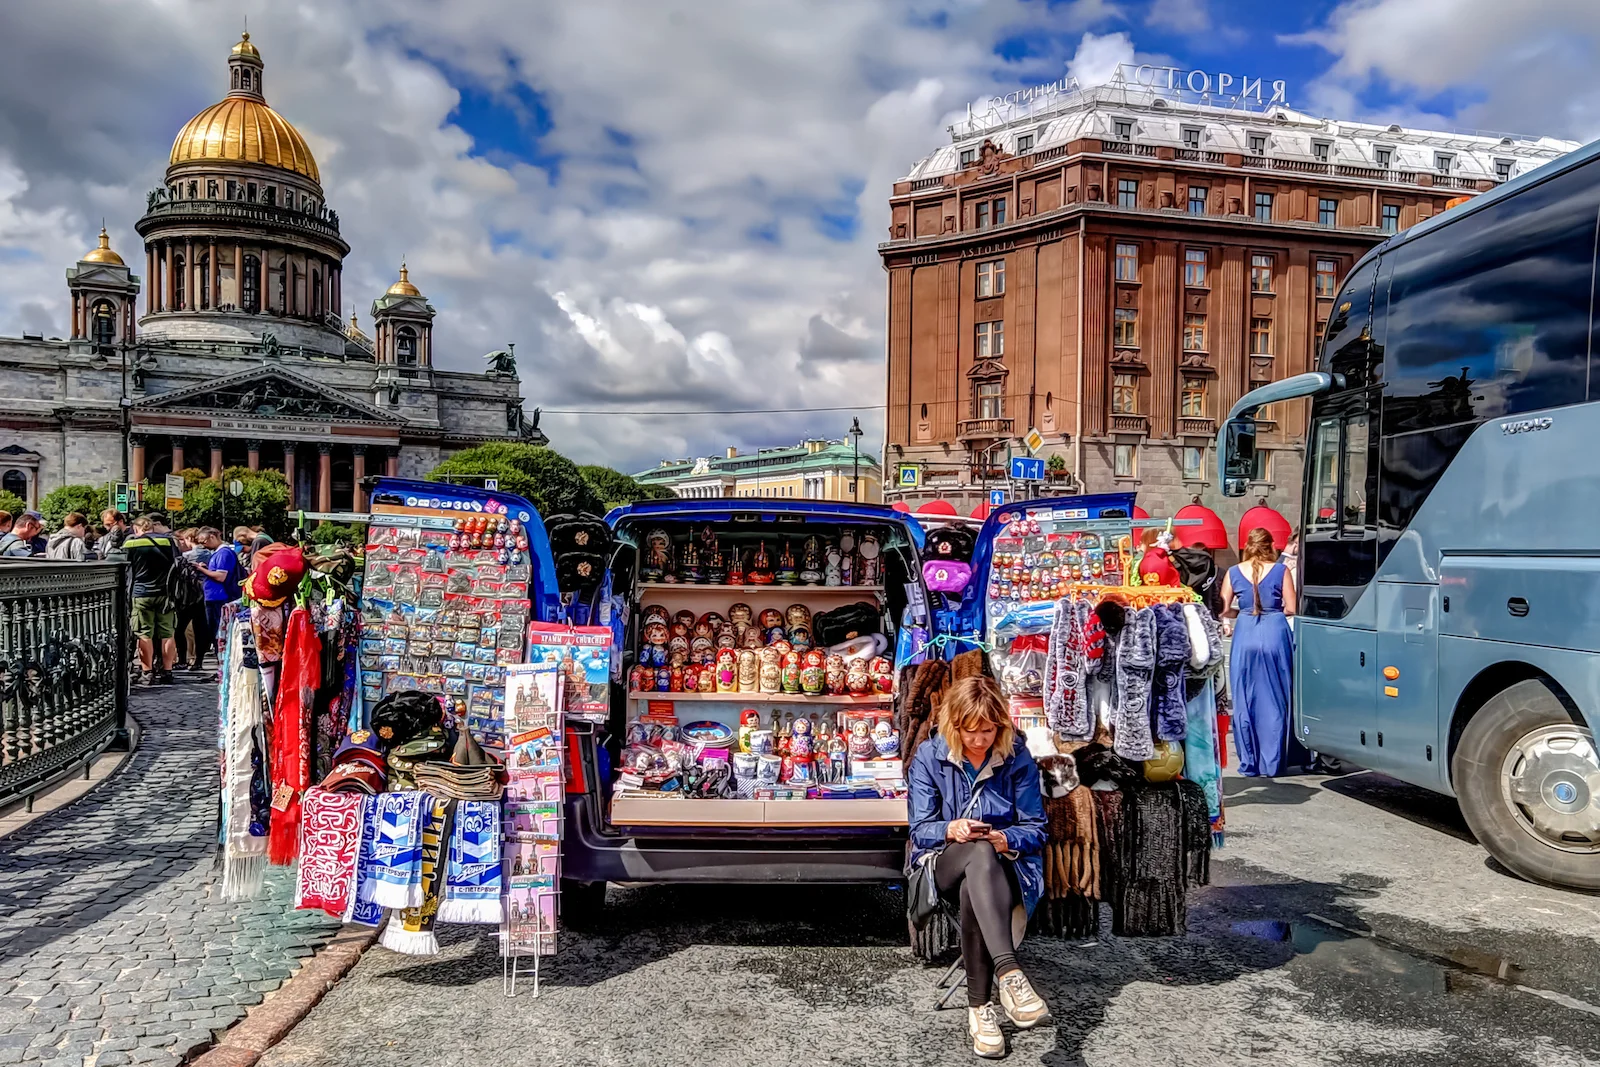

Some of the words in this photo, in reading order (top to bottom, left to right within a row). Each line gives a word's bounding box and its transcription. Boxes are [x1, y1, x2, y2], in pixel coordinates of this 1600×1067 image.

[986, 77, 1080, 110] ГОСТИНИЦА
[1109, 61, 1286, 103] АСТОРИЯ
[911, 254, 939, 265] HOTEL
[959, 242, 1017, 258] ASTORIA
[1035, 230, 1063, 244] HOTEL
[1500, 417, 1553, 435] YUTONG
[575, 636, 606, 645] CHURCHES
[315, 792, 345, 876] ОССИЯ
[371, 866, 410, 877] СПЕТЕРБУРГ
